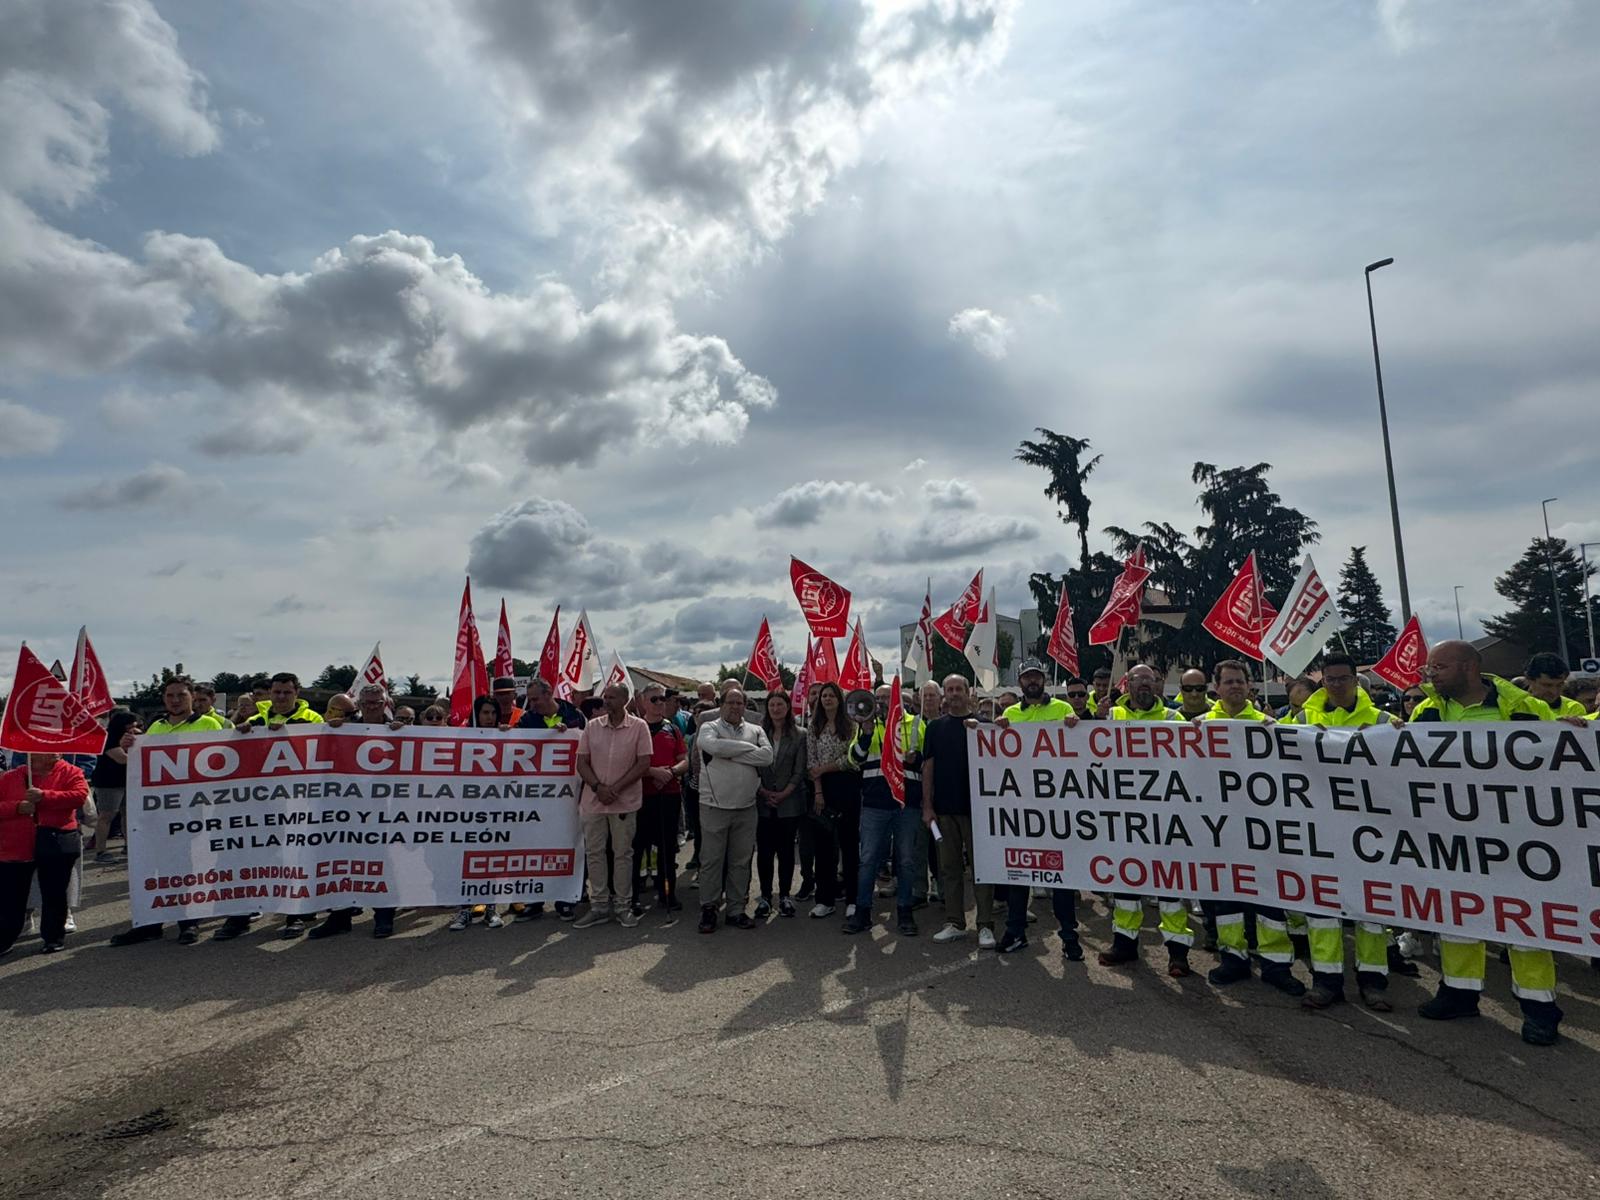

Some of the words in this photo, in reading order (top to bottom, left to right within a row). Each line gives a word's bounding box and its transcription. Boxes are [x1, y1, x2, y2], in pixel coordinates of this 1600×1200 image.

[1276, 575, 1324, 649] CCOO
[1307, 608, 1331, 635] León
[28, 683, 66, 733] UGT
[149, 745, 240, 782] NO
[261, 739, 334, 773] AL
[355, 740, 571, 772] CIERRE
[976, 728, 1022, 758] NO
[1032, 727, 1078, 758] AL
[1089, 726, 1231, 758] CIERRE
[1244, 726, 1302, 761] DE
[1315, 732, 1377, 766] LA
[1391, 730, 1600, 772] AZUCA
[143, 793, 181, 811] DE
[189, 782, 363, 807] AZUCARERA
[371, 783, 410, 798] DE
[417, 783, 455, 799] LA
[462, 781, 575, 799] BAÑEZA
[978, 768, 1021, 797] LA
[1032, 762, 1202, 802] BAÑEZA.
[1218, 770, 1314, 808] POR
[1328, 776, 1391, 815] EL
[169, 818, 222, 835] POR
[229, 815, 258, 828] EL
[264, 810, 350, 826] EMPLEO
[357, 811, 371, 824] Y
[378, 811, 409, 823] LA
[417, 810, 541, 823] INDUSTRIA
[210, 837, 244, 852] EN
[251, 834, 281, 848] LA
[286, 831, 406, 847] PROVINCIA
[413, 831, 444, 844] DE
[450, 828, 510, 843] LEÓN
[988, 807, 1193, 847] INDUSTRIA
[1200, 815, 1228, 847] Y
[1245, 816, 1334, 859] DEL
[1352, 825, 1561, 882] CAMPO
[469, 855, 542, 873] CCOO
[1007, 850, 1043, 867] UGT
[144, 869, 233, 891] SECCIÓN
[239, 865, 308, 881] SINDICAL
[316, 860, 383, 878] CCOO
[461, 879, 543, 896] industria
[1031, 870, 1063, 883] FICA
[151, 884, 269, 909] AZUCARERA
[273, 884, 288, 898] DE
[289, 884, 310, 898] LA
[316, 878, 388, 896] BAÑEZA
[1089, 855, 1258, 895] COMITE
[1276, 869, 1342, 909] DE
[1363, 879, 1600, 946] EMPRE
